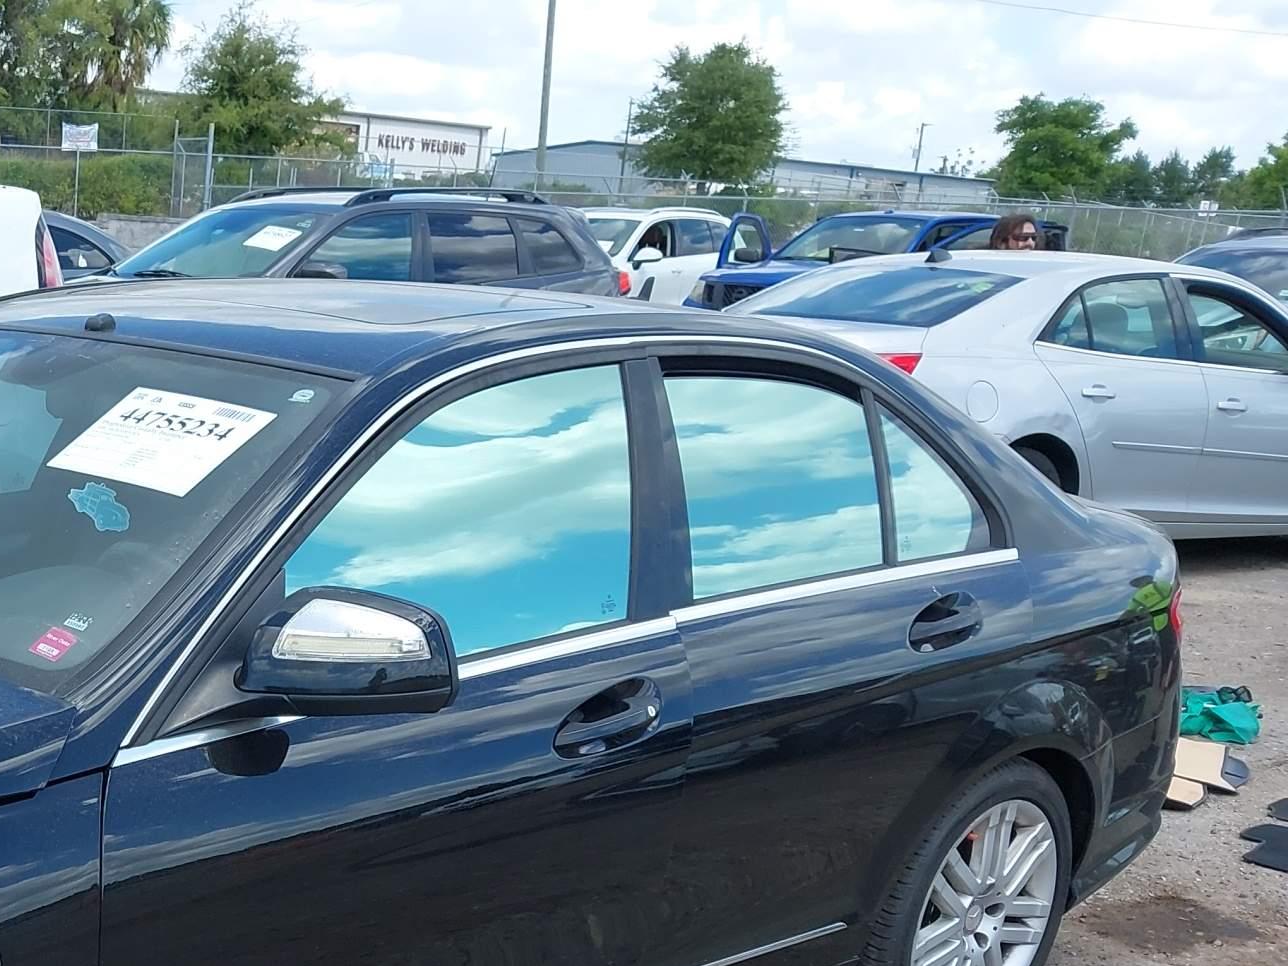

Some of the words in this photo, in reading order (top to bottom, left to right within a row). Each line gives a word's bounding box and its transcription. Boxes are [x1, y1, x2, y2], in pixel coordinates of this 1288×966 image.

[377, 133, 416, 152] KELLY'S
[421, 137, 467, 156] WELDING
[120, 408, 236, 441] 44755234
